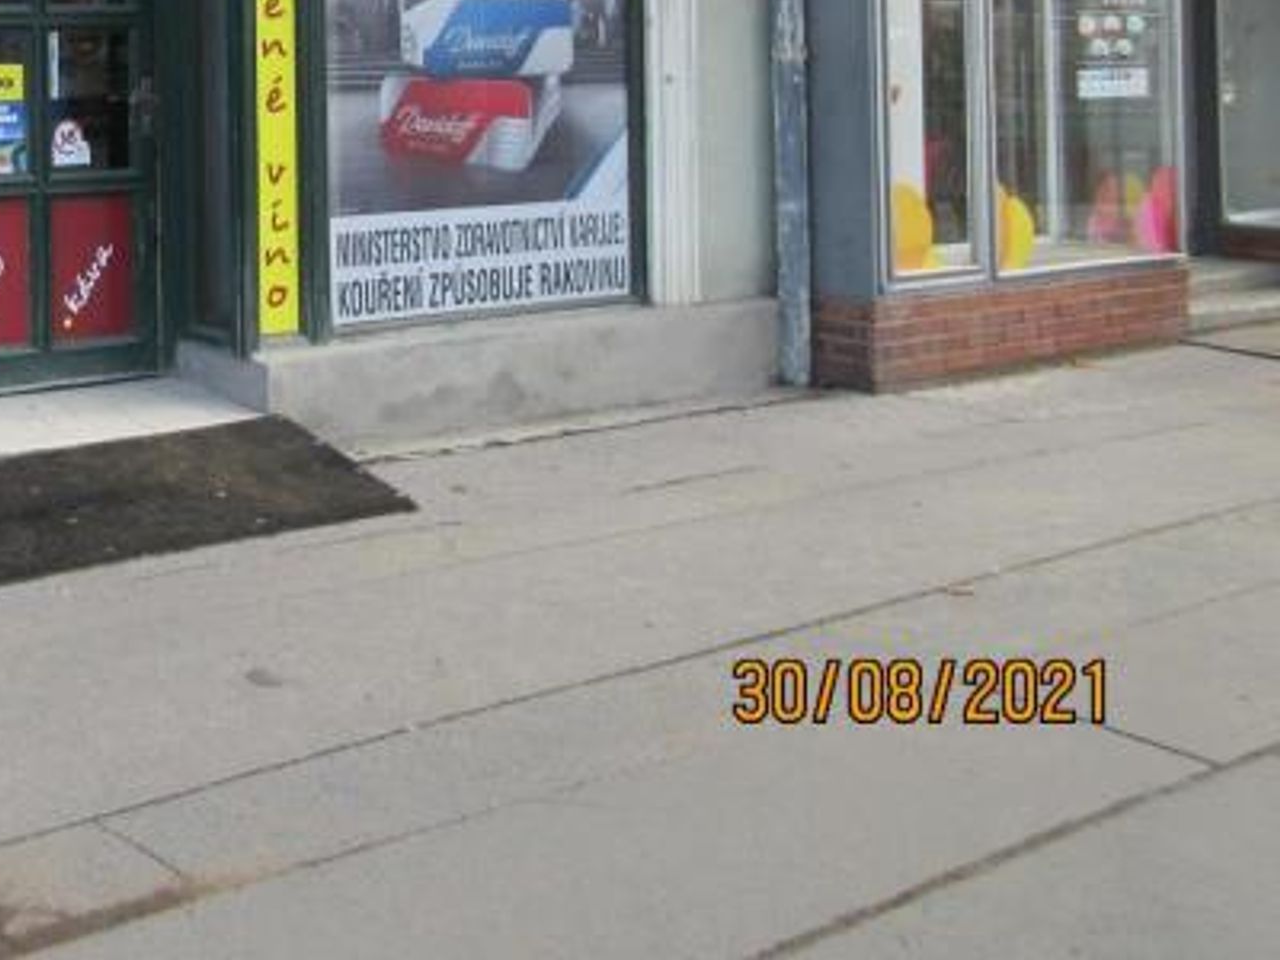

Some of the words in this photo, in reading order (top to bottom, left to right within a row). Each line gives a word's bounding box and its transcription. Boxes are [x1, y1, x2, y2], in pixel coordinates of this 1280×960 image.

[336, 224, 450, 269] MINISTERSTVO
[338, 267, 424, 317] KOUŘENÍ
[539, 256, 626, 296] RAKOVINU
